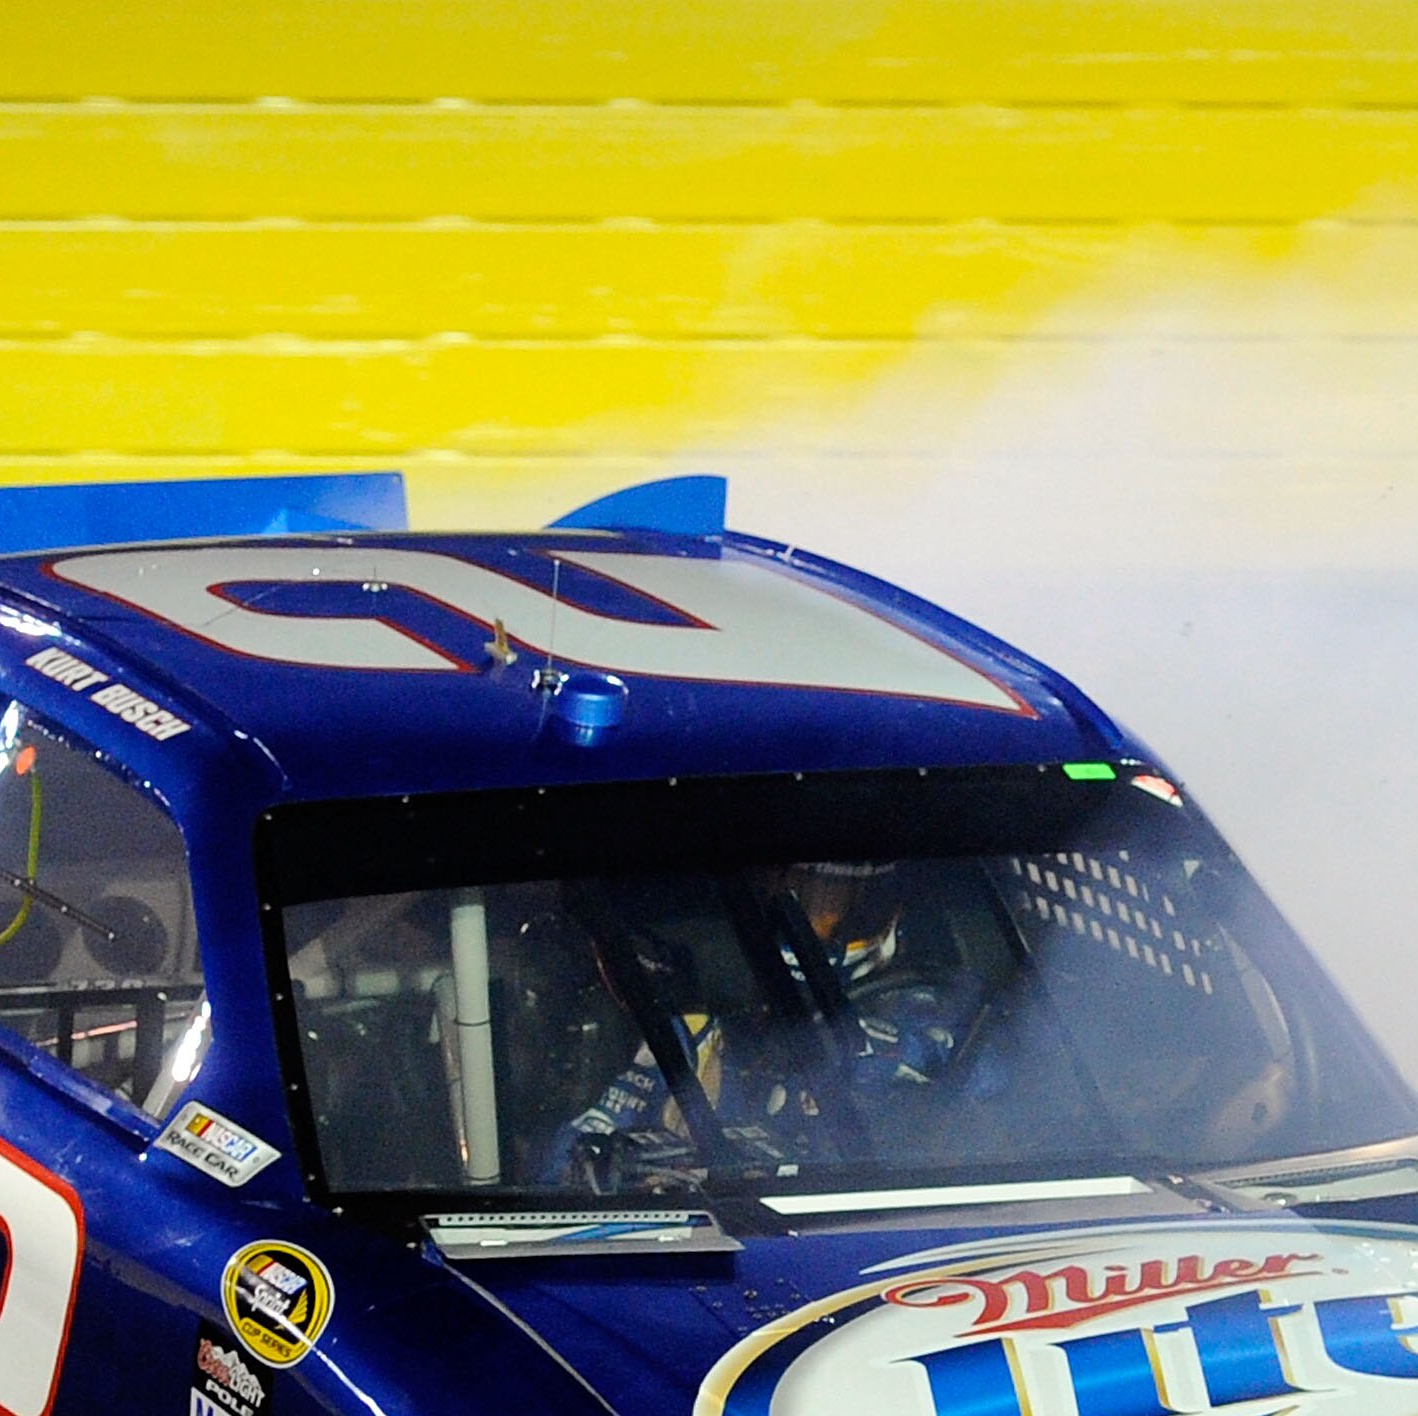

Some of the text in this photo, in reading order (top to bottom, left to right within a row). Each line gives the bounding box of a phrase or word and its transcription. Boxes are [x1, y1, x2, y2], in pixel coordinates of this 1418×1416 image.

[47, 546, 1043, 722] 2
[25, 646, 193, 741] KURT BUSCH
[204, 1151, 238, 1179] CAR
[884, 1250, 1323, 1334] Miller
